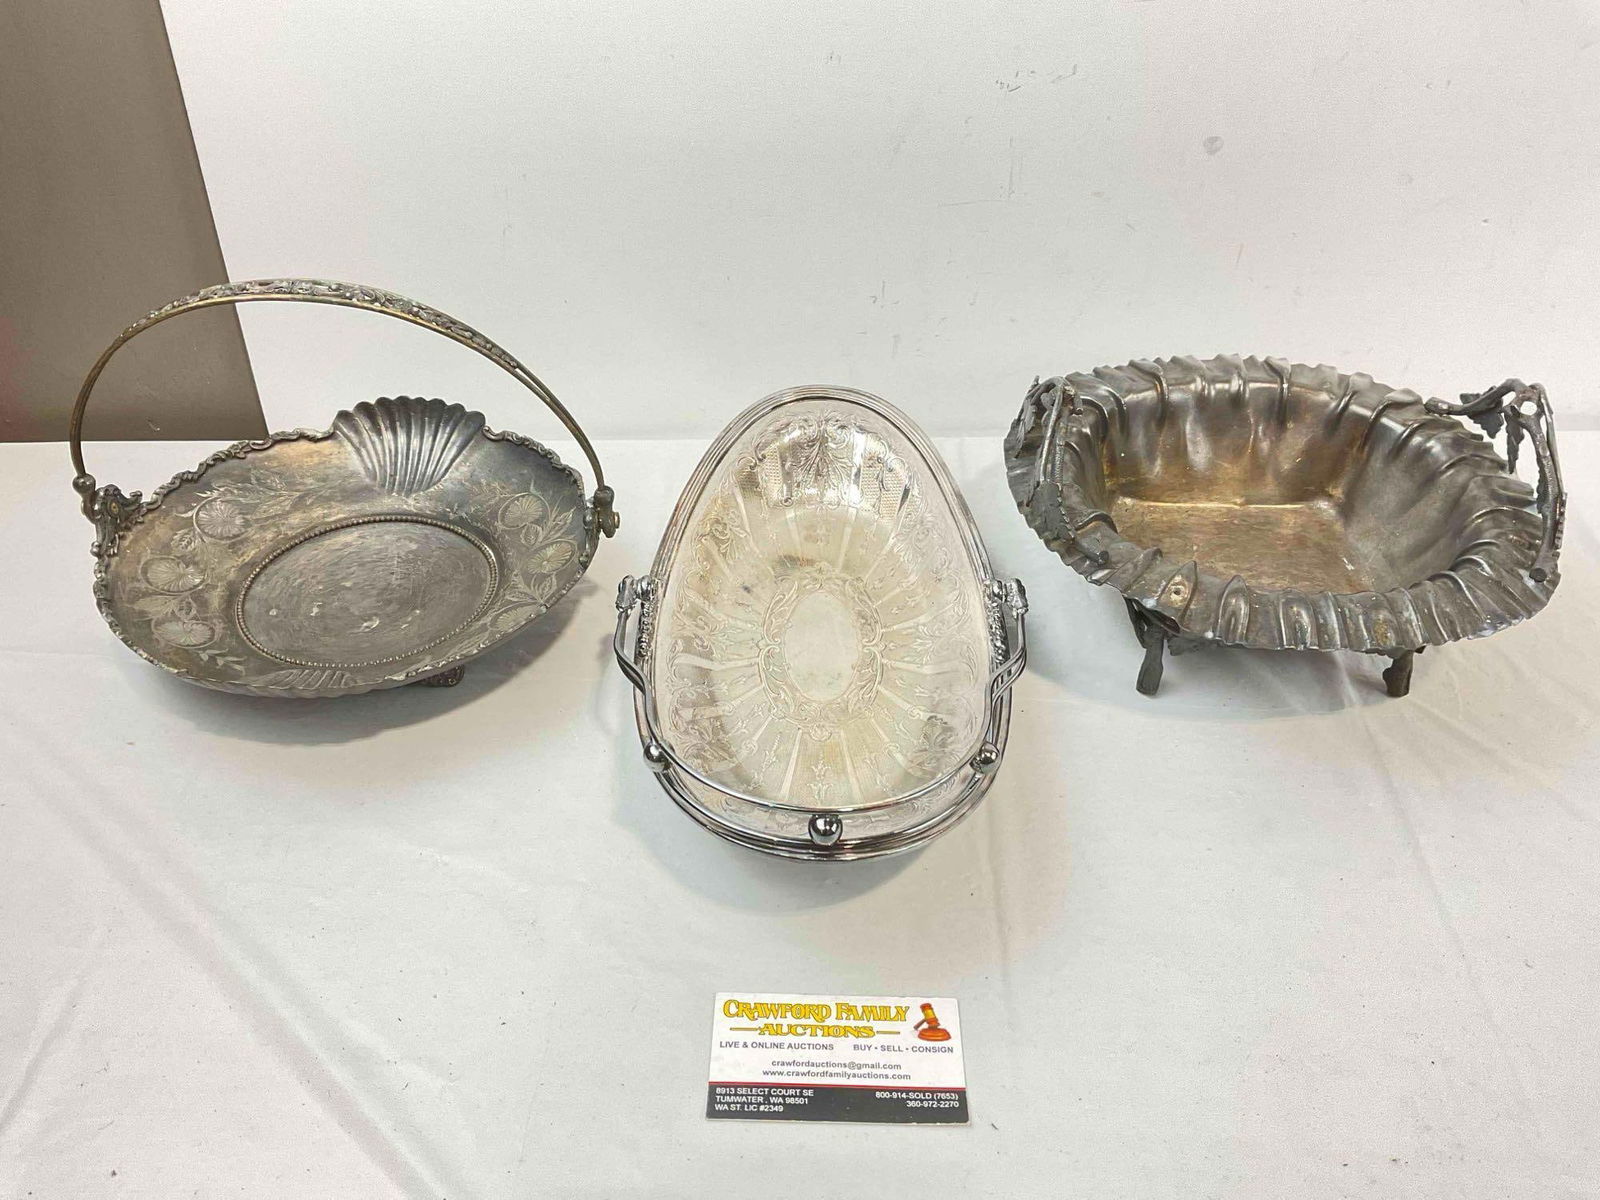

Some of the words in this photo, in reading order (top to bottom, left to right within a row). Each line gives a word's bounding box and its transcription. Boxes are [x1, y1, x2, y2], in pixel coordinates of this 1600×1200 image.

[723, 999, 832, 1023] CRAWFORD
[835, 1002, 910, 1022] FAMILY
[758, 1023, 876, 1039] AUCTIONS
[720, 1041, 740, 1049] LIVE
[742, 1041, 749, 1049] &
[751, 1041, 785, 1050] ONLINE
[787, 1042, 834, 1050] AUCTIONS
[771, 1059, 902, 1070] crawfordauctions@gmail.com
[762, 1069, 911, 1081] www.crawfordfamilyauctions.com
[736, 1087, 769, 1095] SELECT
[770, 1088, 801, 1096] COURT
[802, 1089, 815, 1097] SE
[875, 1091, 932, 1100] 800-914-SOLD
[933, 1092, 959, 1100] (7653)
[769, 1096, 784, 1104] WA
[785, 1097, 809, 1105] 98501
[906, 1100, 960, 1108] 360-972-2270
[714, 1103, 730, 1111] WA
[744, 1104, 758, 1112] LIC
[759, 1104, 784, 1112] #2349
